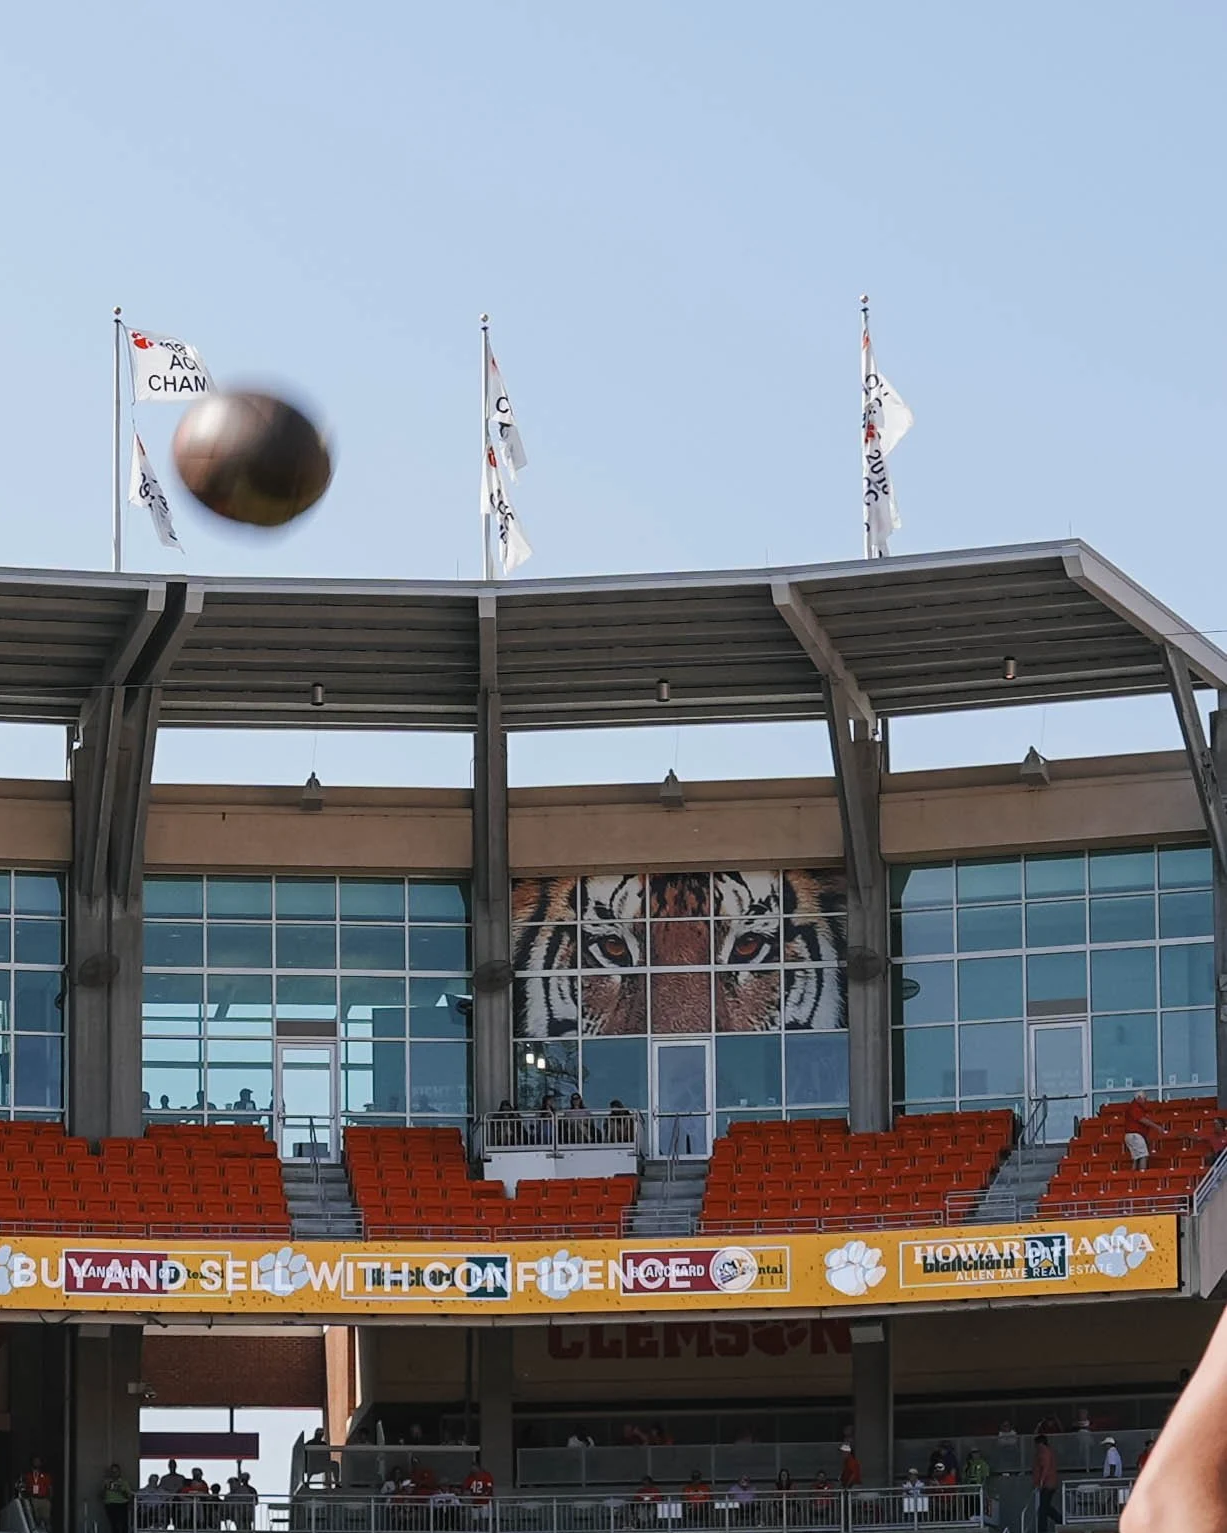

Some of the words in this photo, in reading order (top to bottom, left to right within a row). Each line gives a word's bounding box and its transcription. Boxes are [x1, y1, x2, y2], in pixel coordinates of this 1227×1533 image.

[914, 1239, 1041, 1264] HOWARD
[1052, 1233, 1155, 1258] HANNA
[13, 1257, 93, 1289] BUY
[102, 1259, 187, 1290] AND
[199, 1260, 295, 1292] SELL
[306, 1261, 411, 1293] WITH
[423, 1257, 691, 1293] CONFIDENCE
[956, 1269, 995, 1281] ALLEN
[1000, 1268, 1028, 1280] TATE
[1033, 1266, 1065, 1278] REAL
[1069, 1263, 1113, 1276] ESTATE
